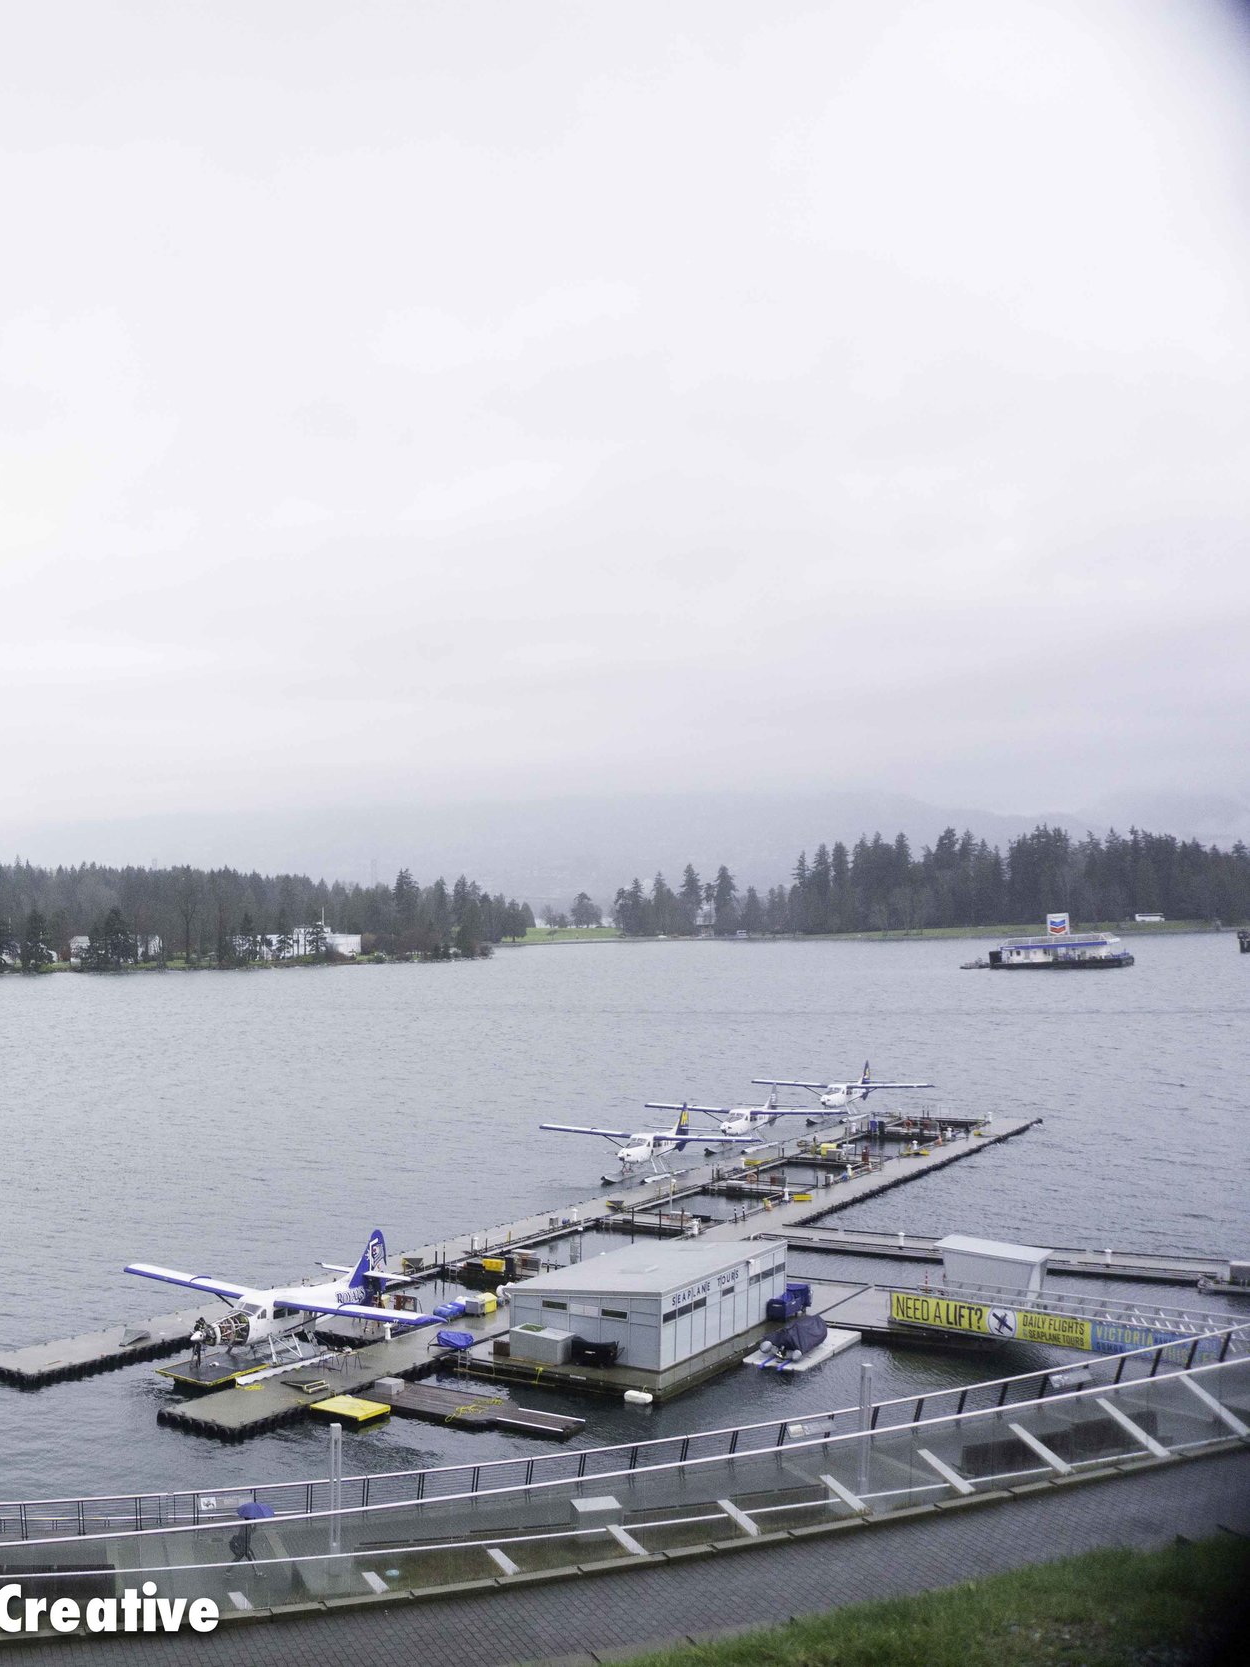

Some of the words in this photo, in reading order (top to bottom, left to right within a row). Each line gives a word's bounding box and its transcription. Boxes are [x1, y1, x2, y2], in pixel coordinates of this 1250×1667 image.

[672, 1281, 710, 1306] SEAPLANE
[717, 1269, 739, 1286] TOURS
[896, 1295, 929, 1321] NEED
[934, 1301, 943, 1324] A
[946, 1303, 983, 1330] LIFT?
[1022, 1314, 1047, 1330] DAILY
[1048, 1318, 1085, 1336] FLIGHTS
[1096, 1325, 1154, 1346] VICTORIA
[1028, 1329, 1061, 1344] SEAPLANE
[1062, 1334, 1085, 1347] TOURS
